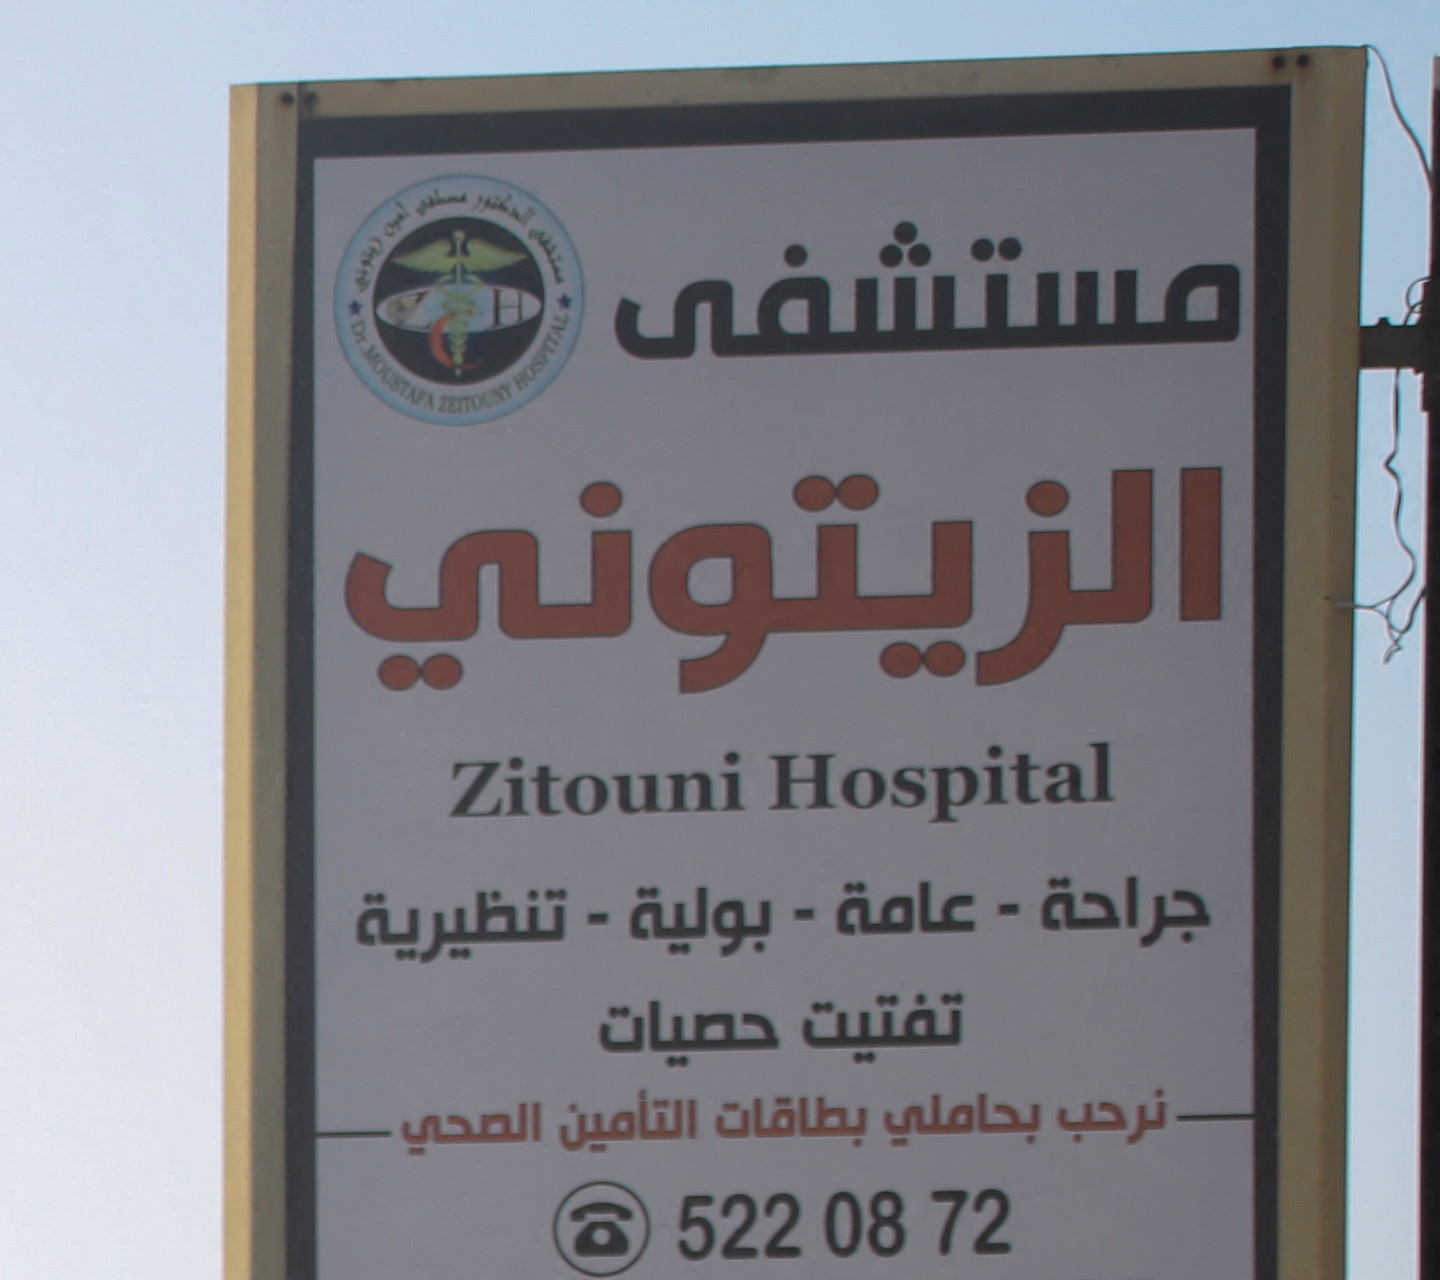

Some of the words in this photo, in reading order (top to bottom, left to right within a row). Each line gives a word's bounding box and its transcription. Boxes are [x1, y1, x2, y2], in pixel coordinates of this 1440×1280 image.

[615, 222, 1241, 359] مستشفى
[513, 313, 569, 391] HOSPITAL
[345, 465, 1224, 694] الزيتوني
[451, 752, 744, 816] Zitouni
[771, 742, 1113, 822] Hospital
[357, 890, 566, 963] تنظيرية
[631, 887, 771, 956] بولية
[837, 882, 974, 935] عامة
[1042, 877, 1210, 947] جراحة
[600, 1001, 779, 1067] حصيات
[803, 994, 963, 1063] تفتيت
[402, 1103, 541, 1155] الصحي
[560, 1090, 697, 1152] التأمين
[716, 1097, 867, 1147] بطاقات
[884, 1094, 1040, 1146] بحاملي
[1058, 1089, 1166, 1144] نرحب
[679, 1193, 801, 1260] 522
[825, 1191, 905, 1257] 08
[932, 1189, 1010, 1255] 72
